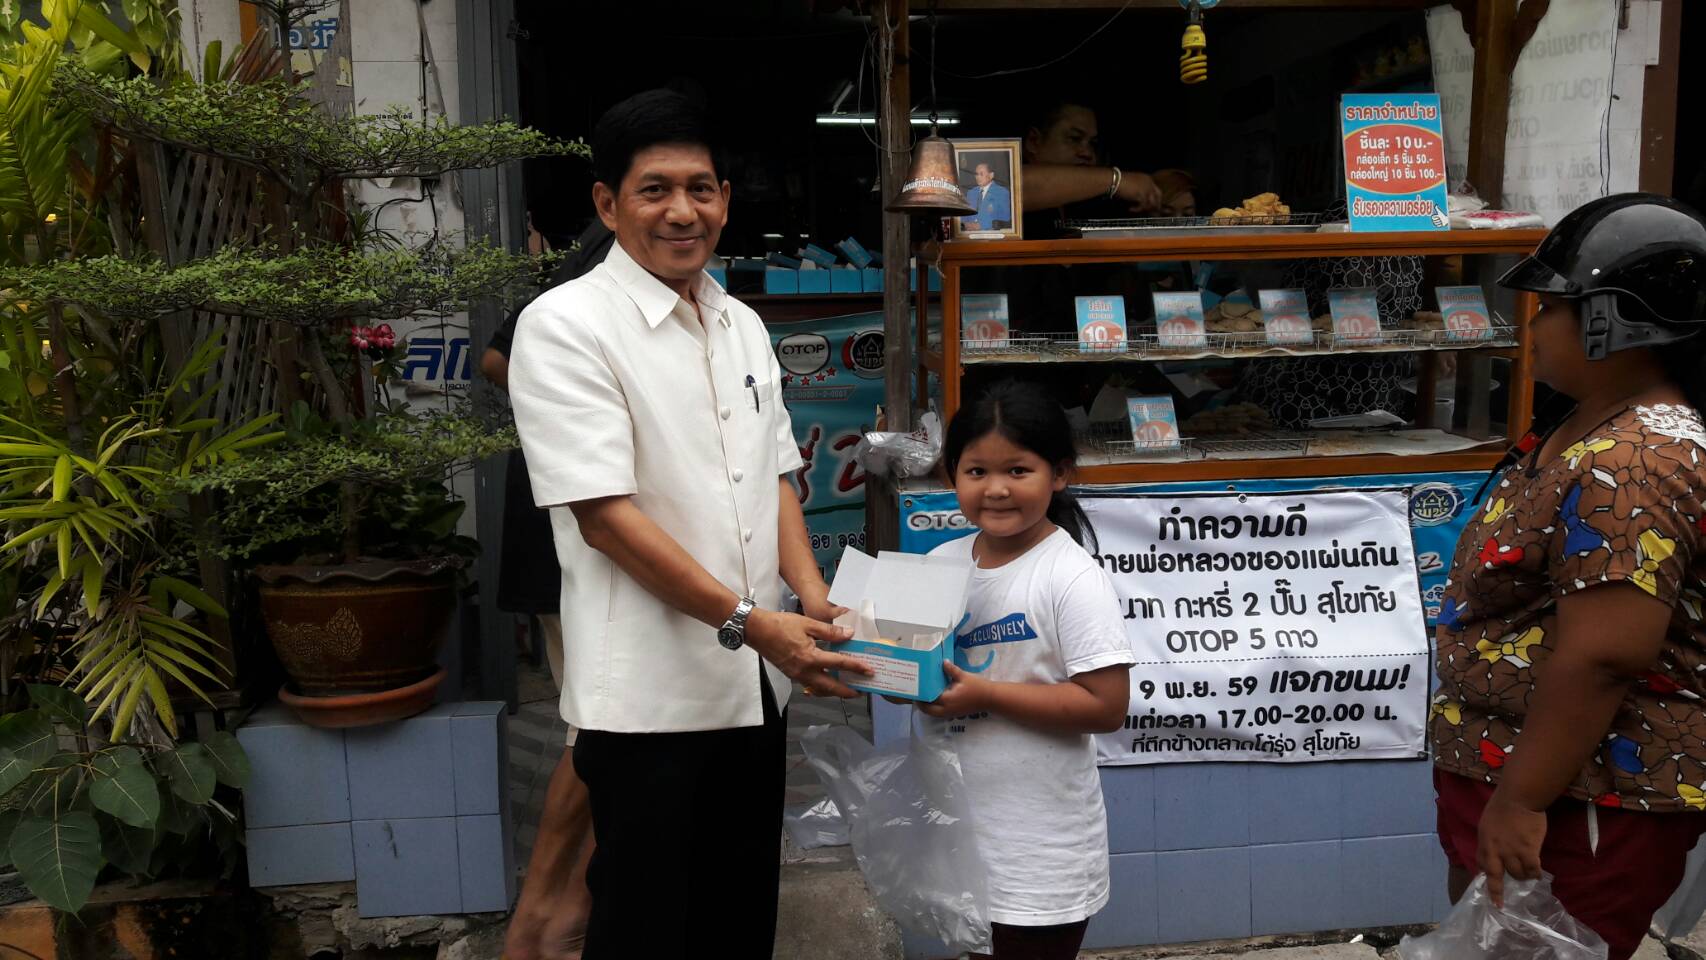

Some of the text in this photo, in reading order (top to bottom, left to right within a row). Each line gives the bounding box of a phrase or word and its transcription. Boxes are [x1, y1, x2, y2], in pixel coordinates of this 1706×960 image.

[1346, 102, 1436, 119] ราคาจำหน่าย
[1360, 130, 1389, 149] ชิ้นละ
[1395, 137, 1411, 149] 10
[1356, 151, 1390, 164] กล่องเล็ก
[1393, 154, 1399, 164] 5
[1402, 150, 1413, 164] ชิ้น
[1350, 167, 1388, 181] กล่องใหญ่
[1391, 169, 1401, 179] 10
[1405, 164, 1416, 179] ชิ้น
[1353, 195, 1433, 217] รับรองความอร่อย
[1084, 326, 1109, 342] 10
[782, 344, 825, 355] OTOP
[1159, 504, 1307, 540] ทำความดี
[1174, 580, 1233, 618] กะหรี่
[1243, 592, 1261, 616] 2
[1317, 580, 1397, 623] สุโขทัย
[1166, 627, 1319, 653] OTOP 5 ดาว
[1139, 664, 1411, 700] 9 พ.ย. 59 แจกขนม!
[1217, 703, 1364, 728] 17.00-20.00
[1374, 705, 1398, 720] น.
[1132, 729, 1360, 757] ที่ตึกข้างตลาดโต้รุ่ง สุโขทัย
